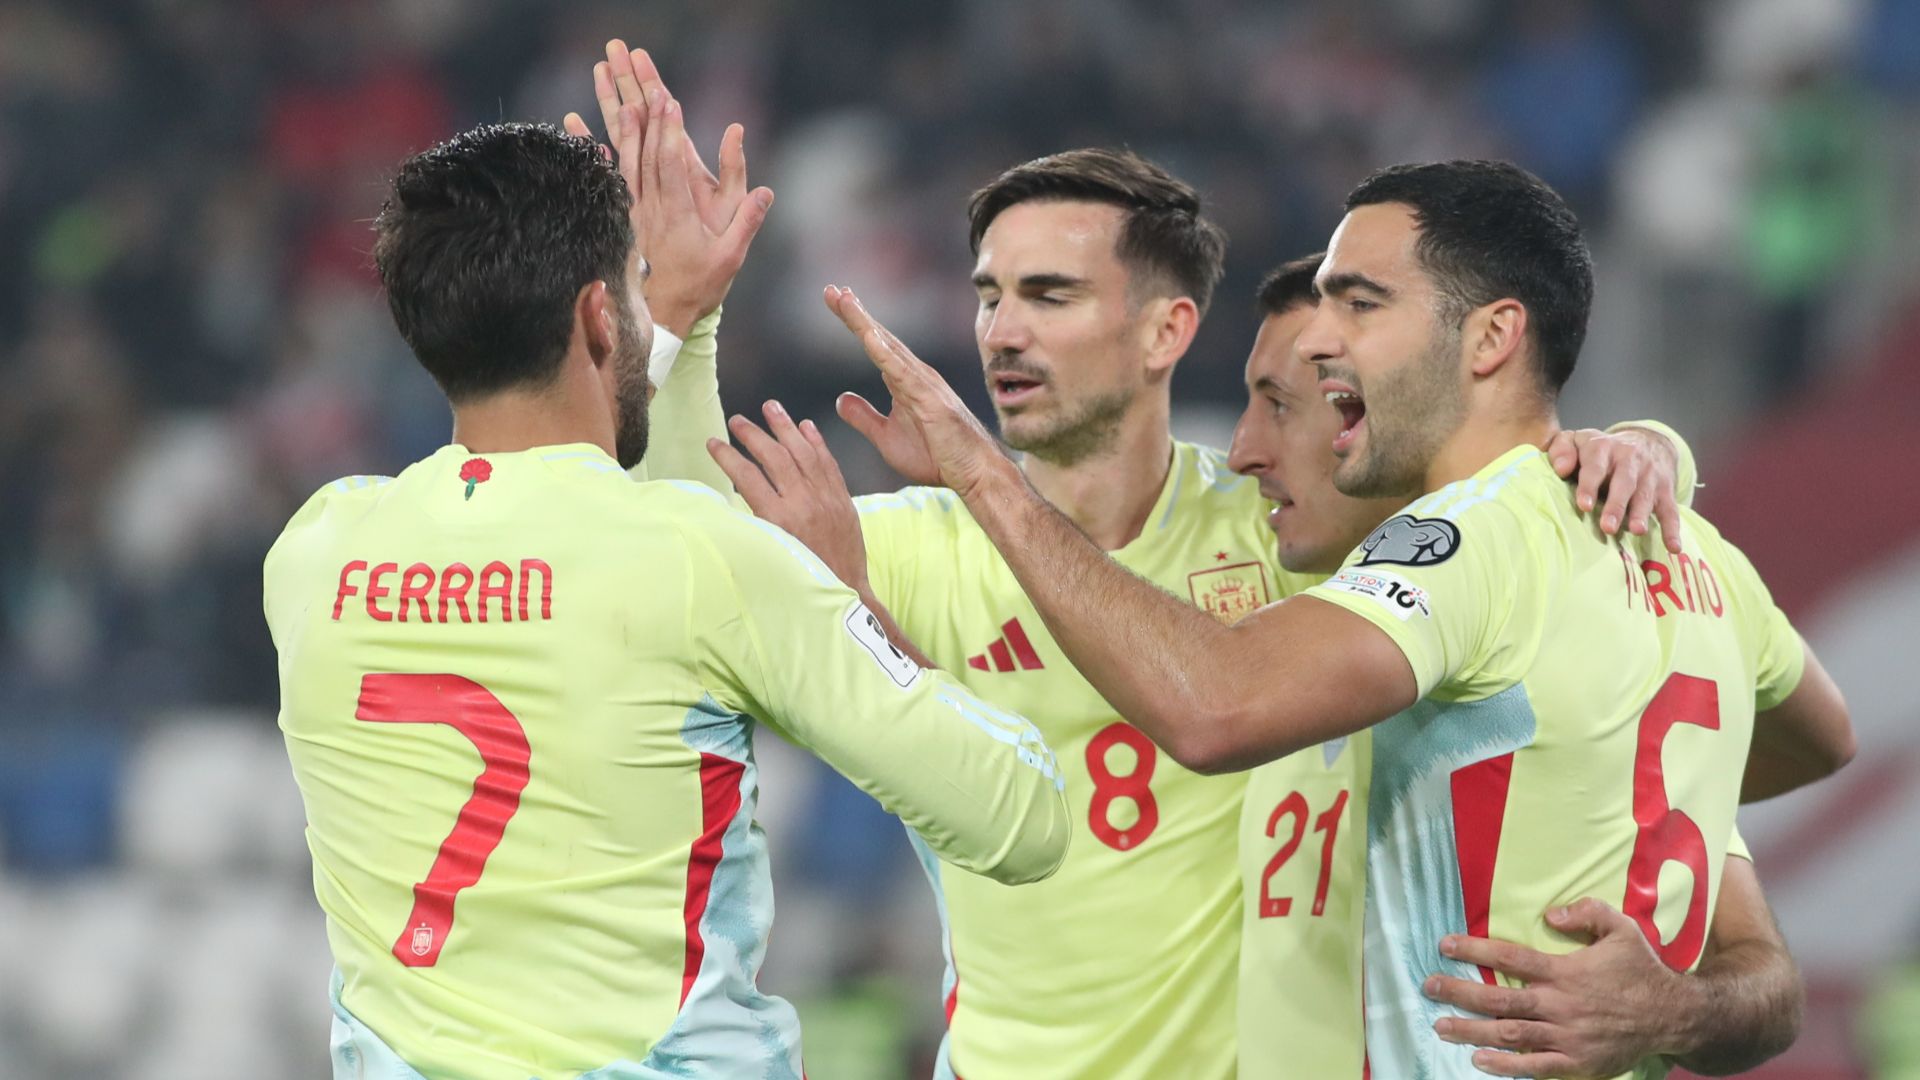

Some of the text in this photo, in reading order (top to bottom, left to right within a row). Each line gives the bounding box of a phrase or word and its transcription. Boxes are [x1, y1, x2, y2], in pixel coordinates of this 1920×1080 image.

[332, 559, 553, 624] FERRAN
[1386, 581, 1417, 609] 10
[355, 673, 531, 967] 7
[1085, 721, 1159, 852] 8
[1624, 672, 1720, 974] 6
[1259, 789, 1350, 919] 21
